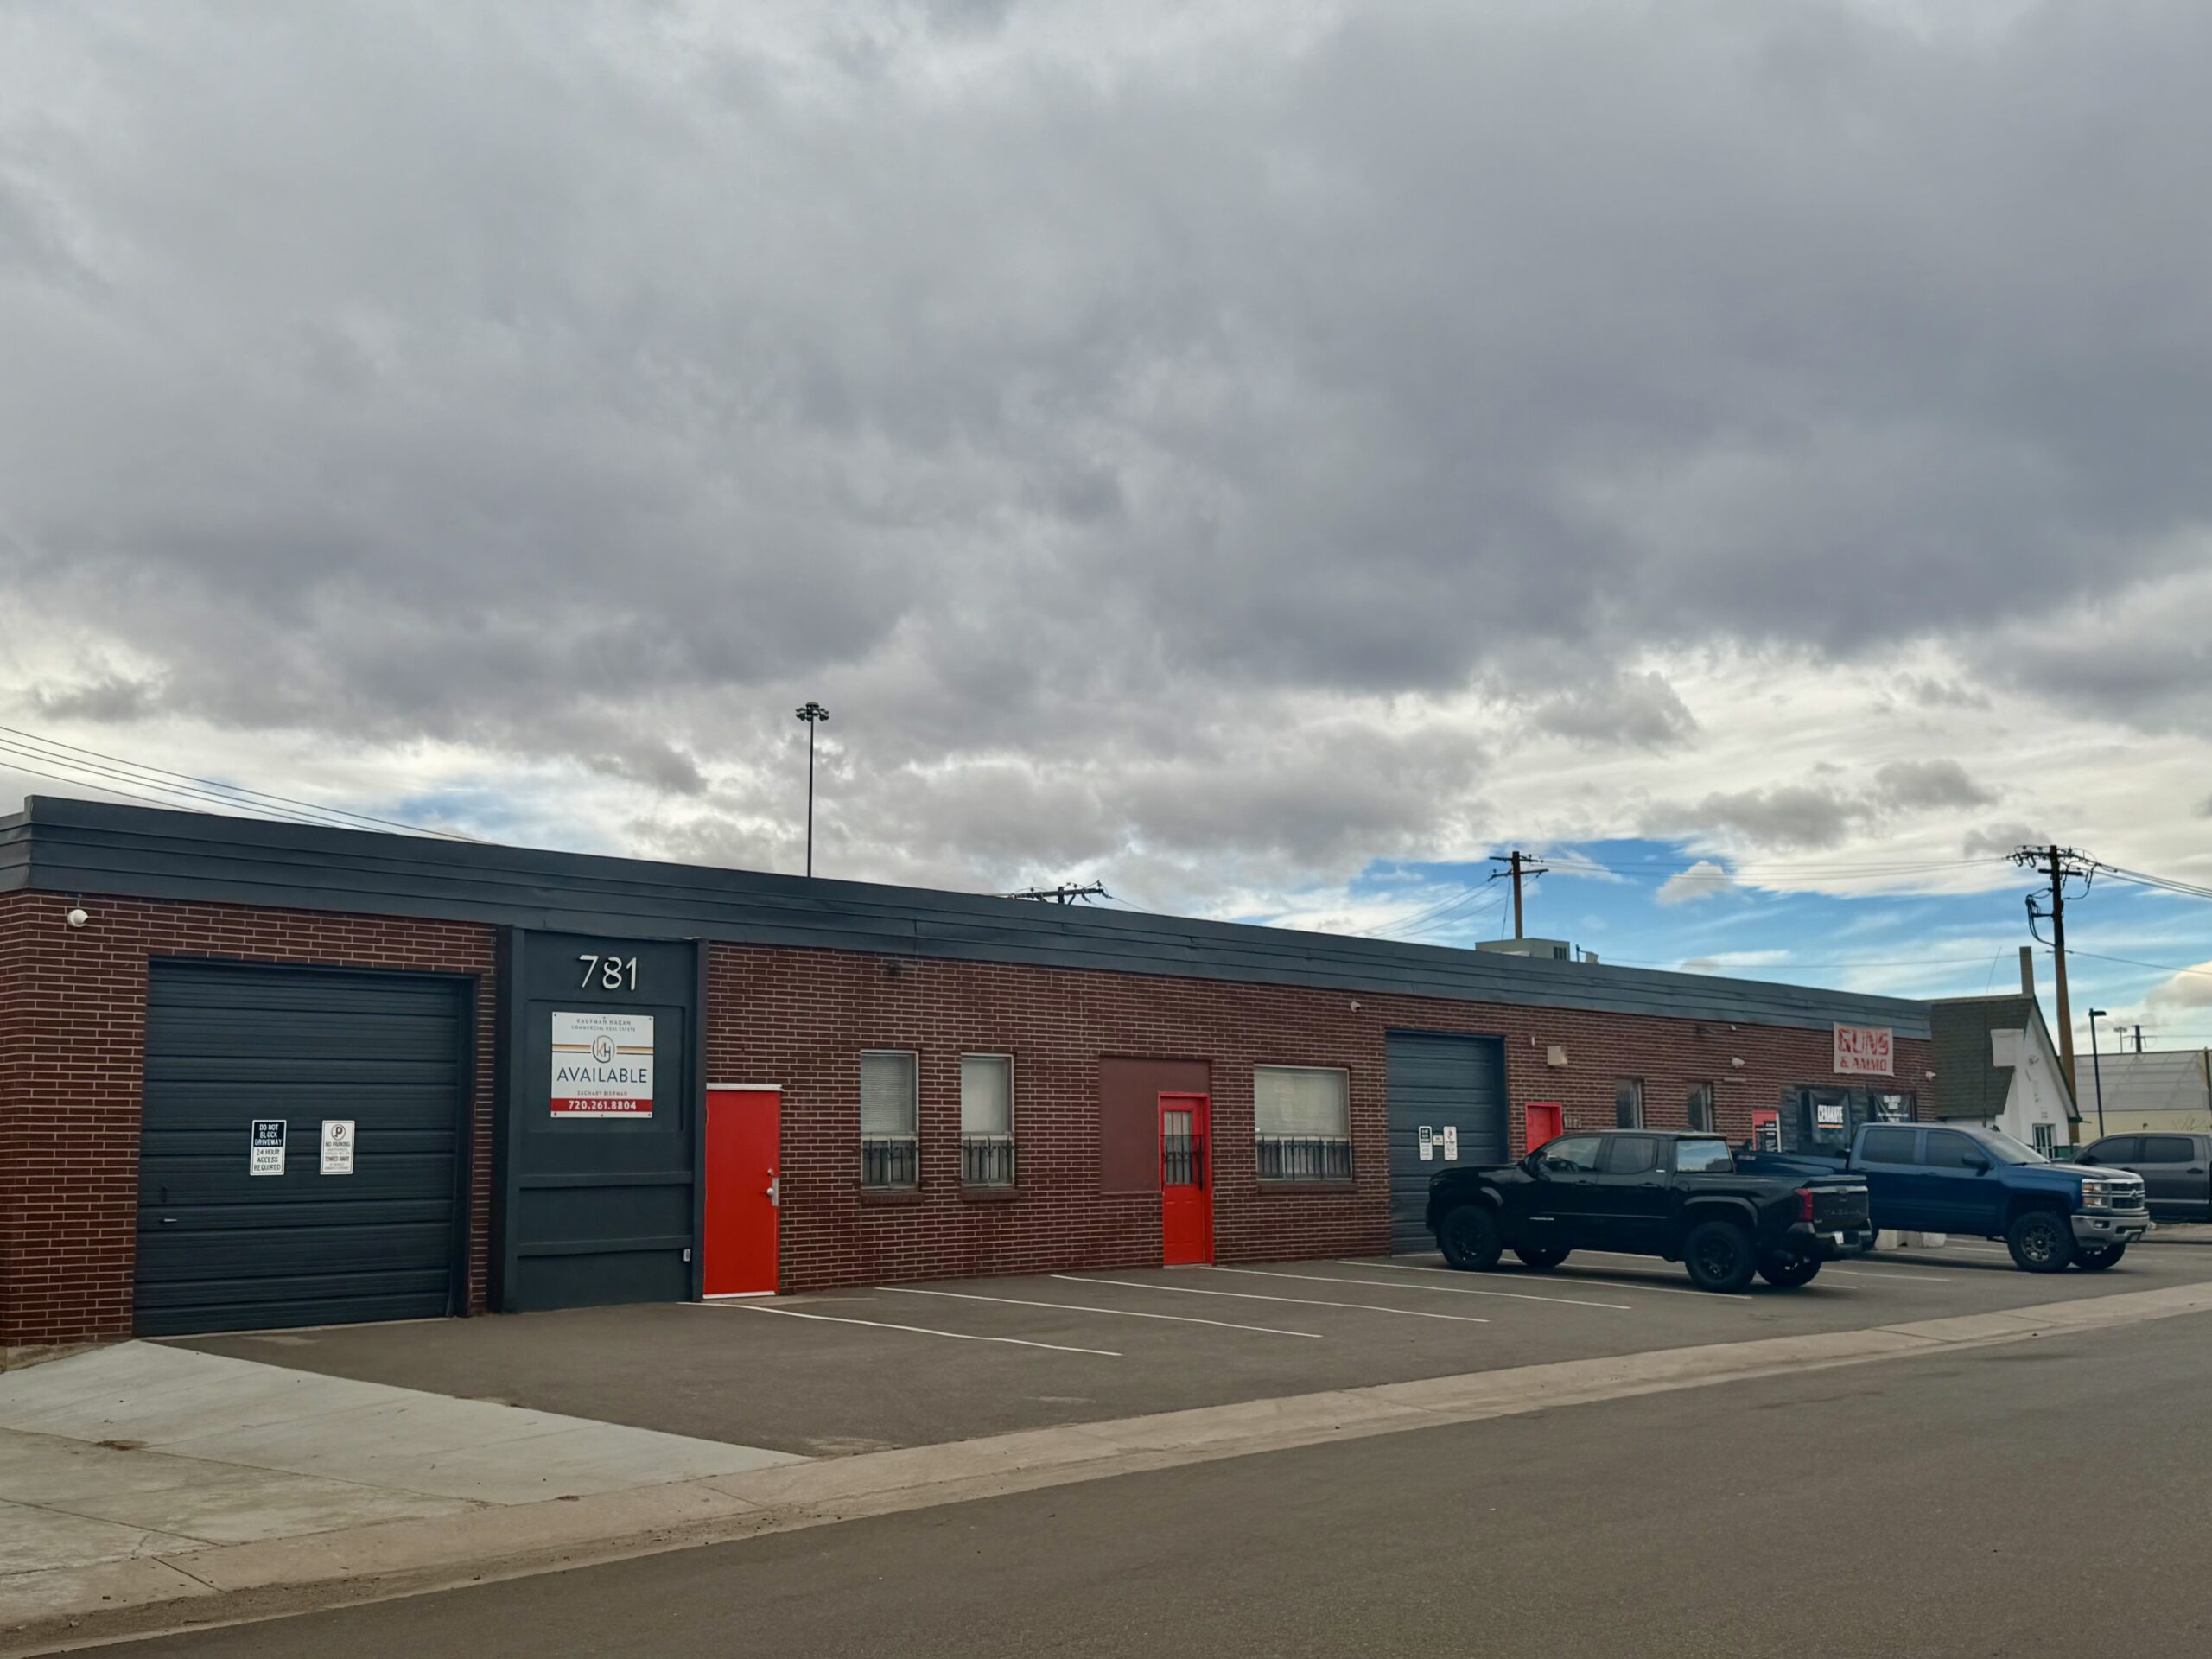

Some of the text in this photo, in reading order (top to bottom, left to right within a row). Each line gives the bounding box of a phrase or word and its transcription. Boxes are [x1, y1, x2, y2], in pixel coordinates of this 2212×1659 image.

[579, 954, 637, 991] 781
[1838, 1028, 1889, 1056] GUNS
[1853, 1057, 1887, 1071] AMMO
[556, 1066, 647, 1084] AVAILABLE
[569, 1100, 637, 1110] 720.261.8804
